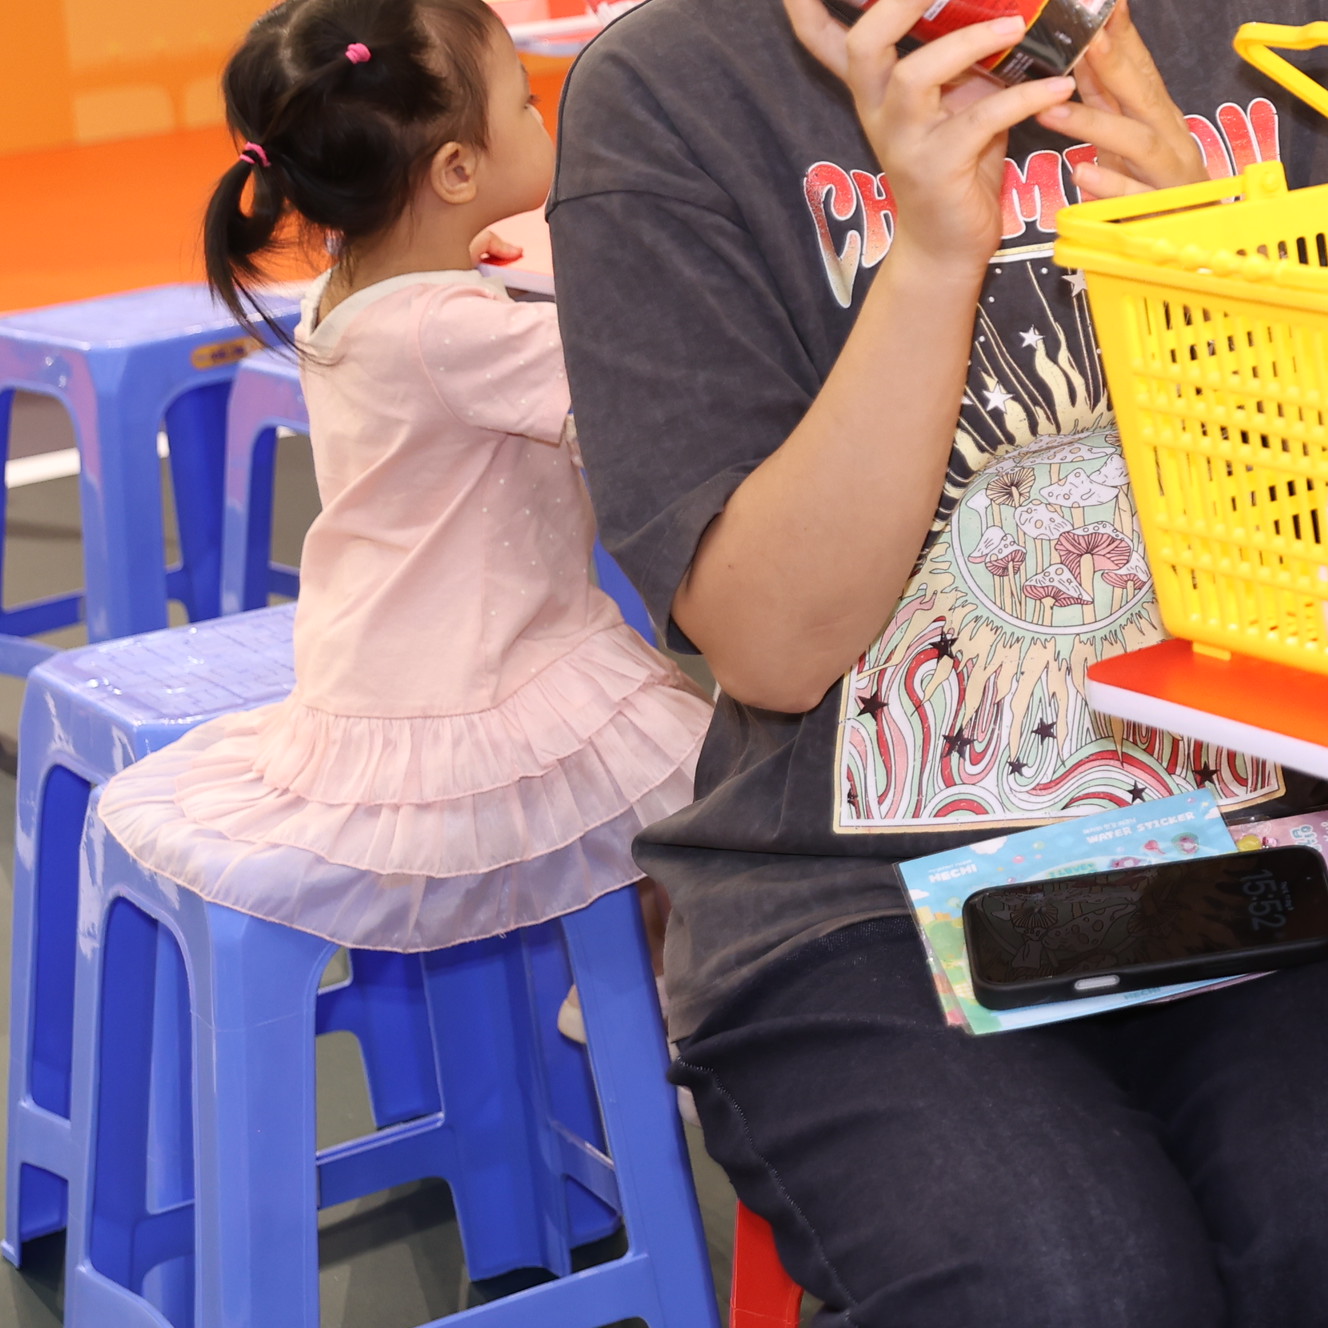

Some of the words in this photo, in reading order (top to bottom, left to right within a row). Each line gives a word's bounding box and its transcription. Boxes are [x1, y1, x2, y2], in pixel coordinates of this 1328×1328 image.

[1086, 826, 1133, 845] WATER
[1136, 811, 1196, 833] STICKER
[928, 863, 978, 884] HECHI
[1240, 869, 1287, 931] 15:52
